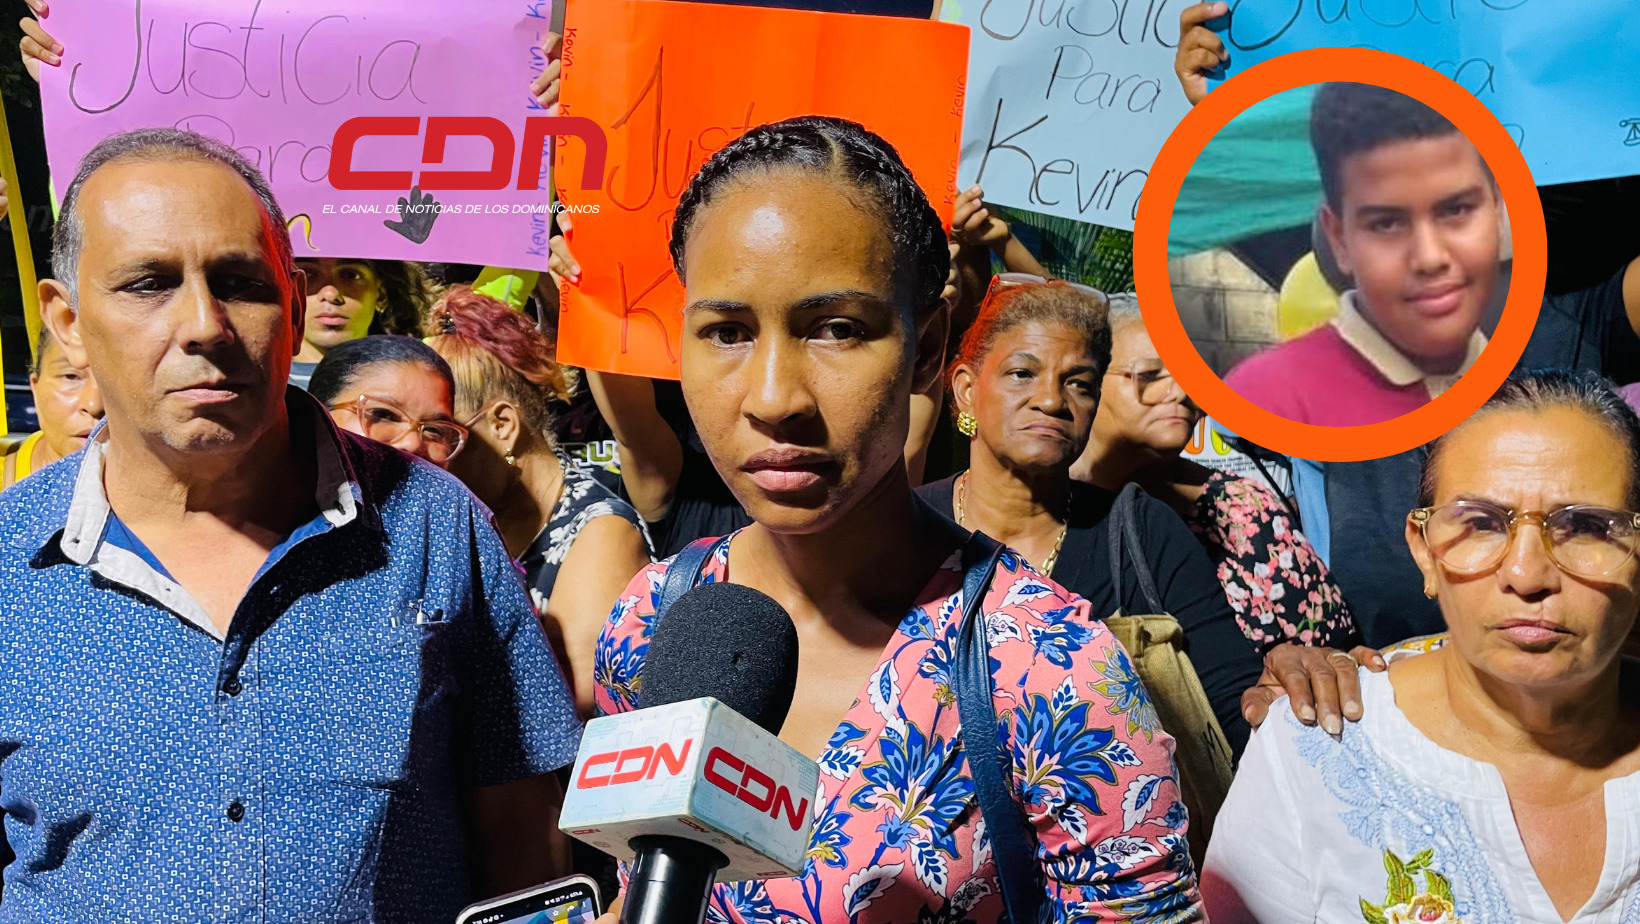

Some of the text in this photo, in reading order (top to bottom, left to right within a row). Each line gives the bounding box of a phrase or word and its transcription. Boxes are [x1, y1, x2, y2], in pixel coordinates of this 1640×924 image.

[1046, 45, 1162, 113] Para
[976, 98, 1150, 221] Kevin
[577, 738, 692, 789] CDN
[704, 746, 808, 831] CDN
